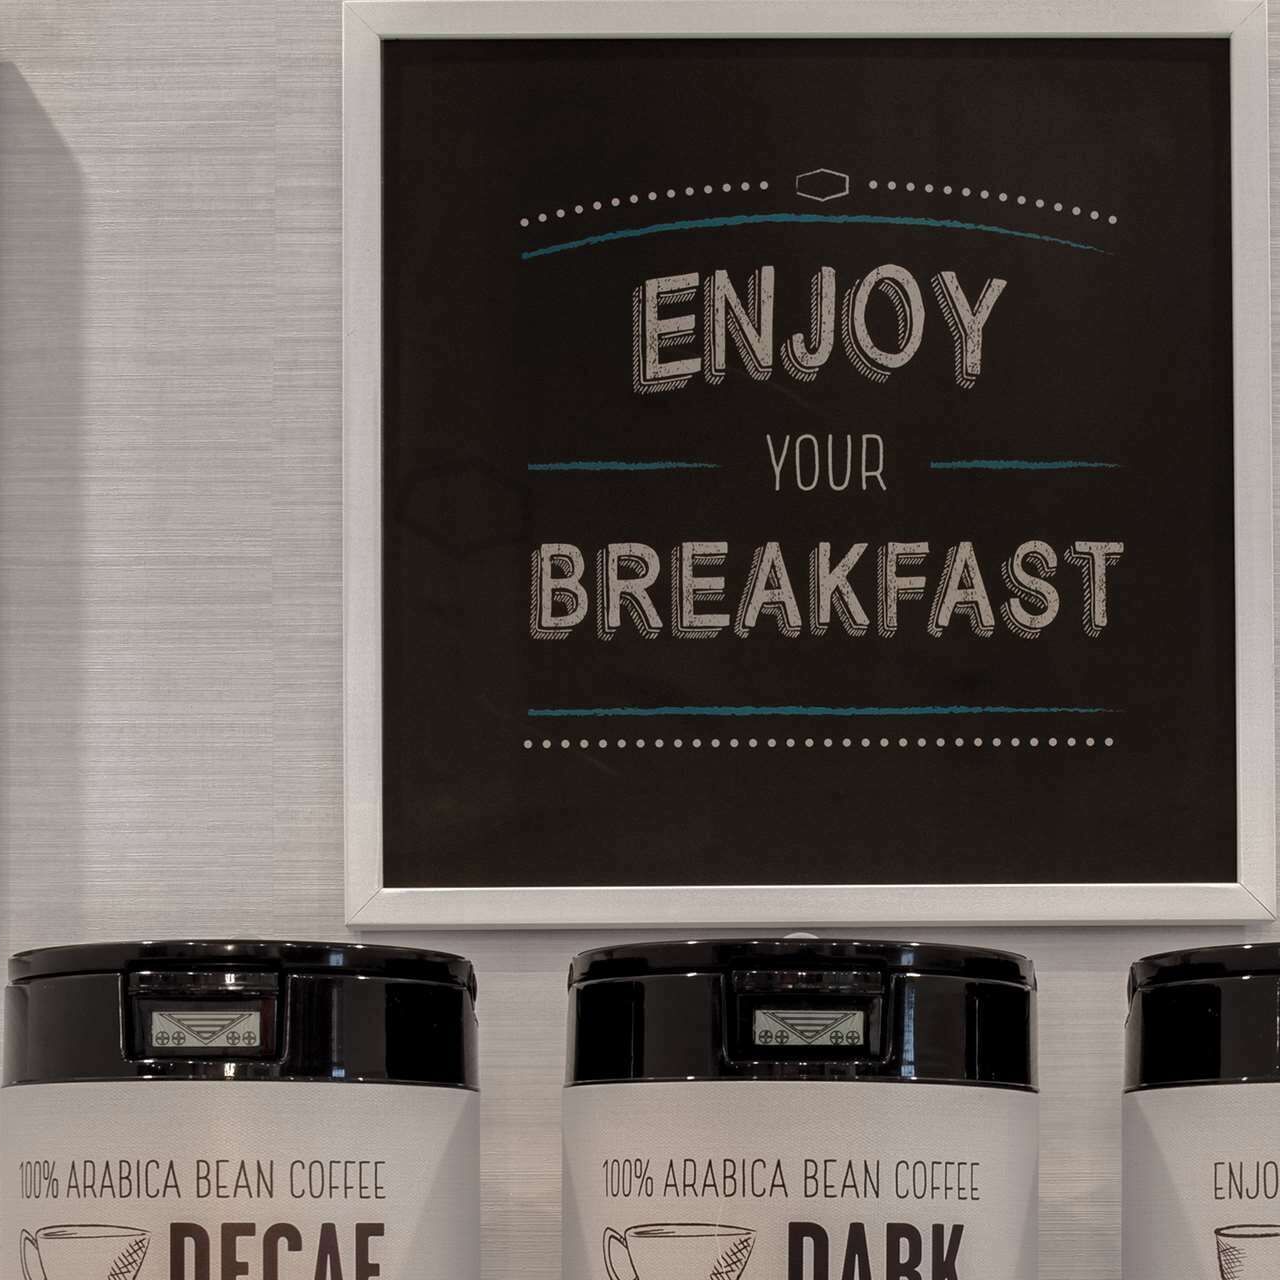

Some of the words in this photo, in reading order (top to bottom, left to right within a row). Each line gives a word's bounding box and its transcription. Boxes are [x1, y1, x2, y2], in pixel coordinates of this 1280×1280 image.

[634, 264, 1007, 394] ENJOY
[766, 434, 887, 491] YOUR
[529, 541, 1125, 640] BREAKFAST
[20, 1159, 59, 1199] 100%
[66, 1160, 181, 1199] ARABICA
[196, 1159, 274, 1199] BEAN
[290, 1160, 386, 1200] COFFEE
[603, 1159, 654, 1199] 100%
[663, 1159, 788, 1199] ARABICA
[804, 1159, 881, 1199] BEAN
[895, 1160, 980, 1200] COFFEE
